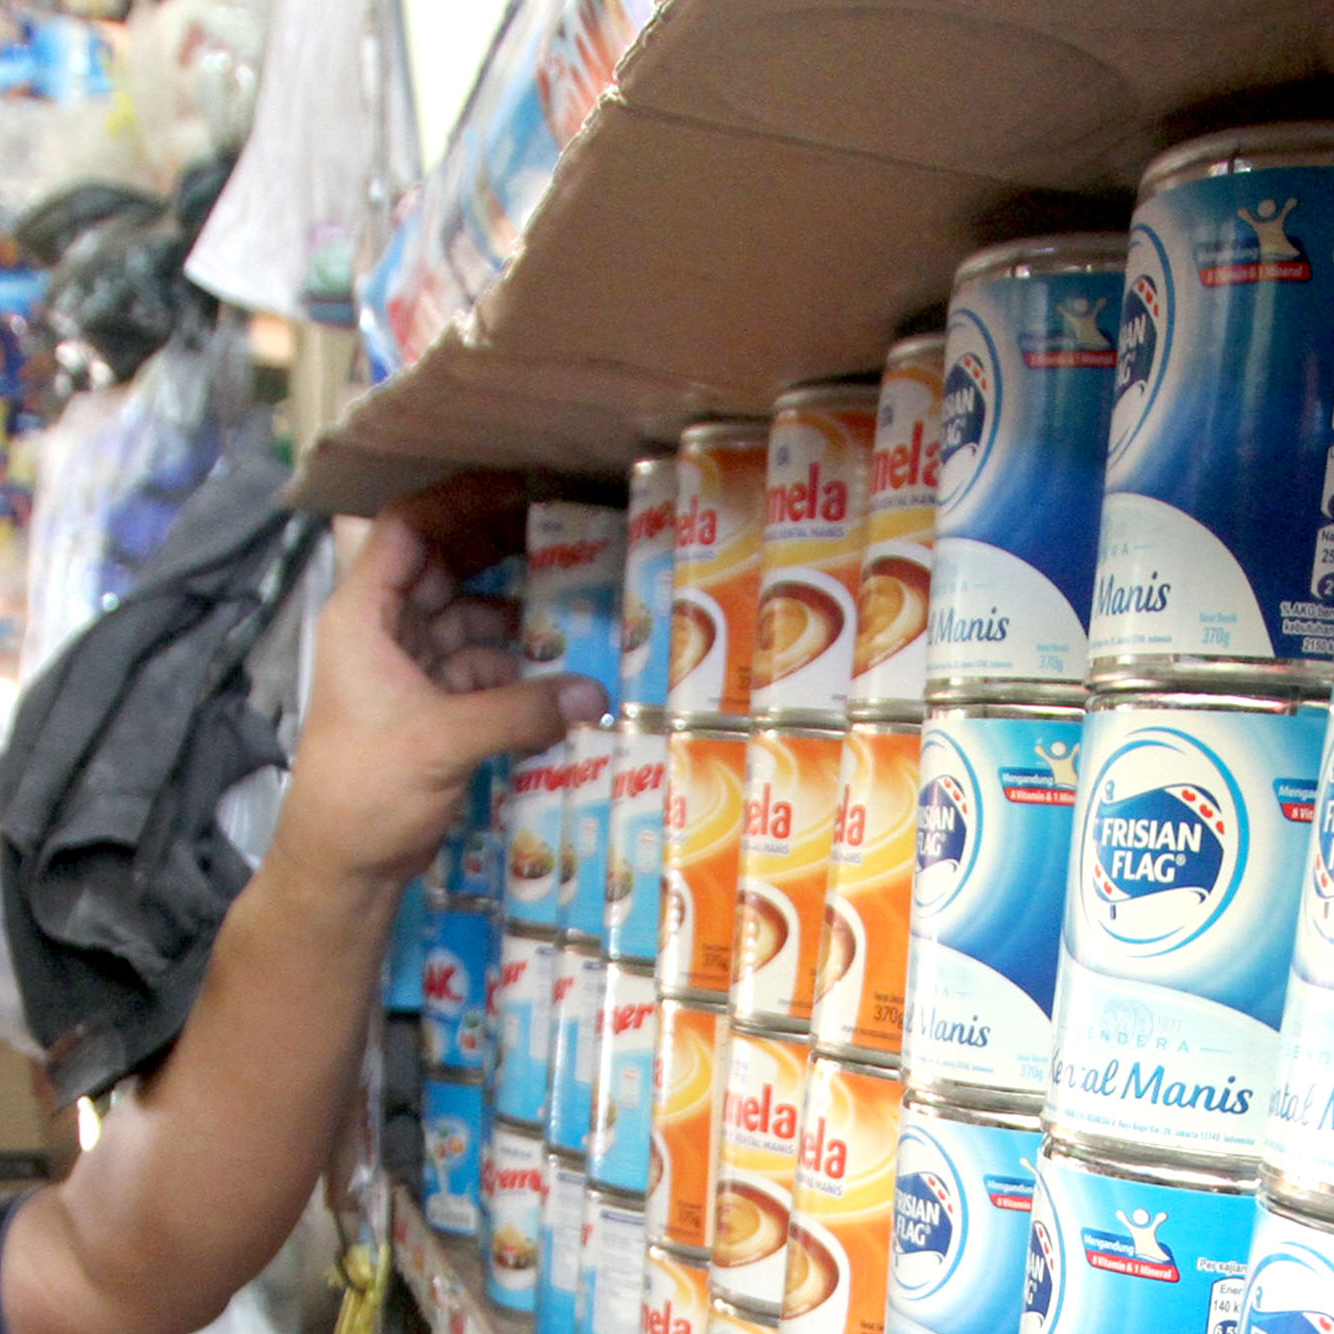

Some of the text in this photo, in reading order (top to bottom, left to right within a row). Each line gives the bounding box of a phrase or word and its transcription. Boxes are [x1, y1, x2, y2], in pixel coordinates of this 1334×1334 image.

[1097, 571, 1170, 618] Manis
[935, 605, 1010, 644] Manis
[1201, 626, 1231, 647] 370g
[1100, 816, 1204, 854] FRISIAN
[1076, 1024, 1191, 1055] ENDERA
[1120, 1061, 1254, 1116] Manis
[1084, 1233, 1135, 1257] Mengandung
[1097, 1255, 1126, 1272] Vitamin
[1139, 1263, 1172, 1280] Mineral
[1213, 1298, 1231, 1313] 140
